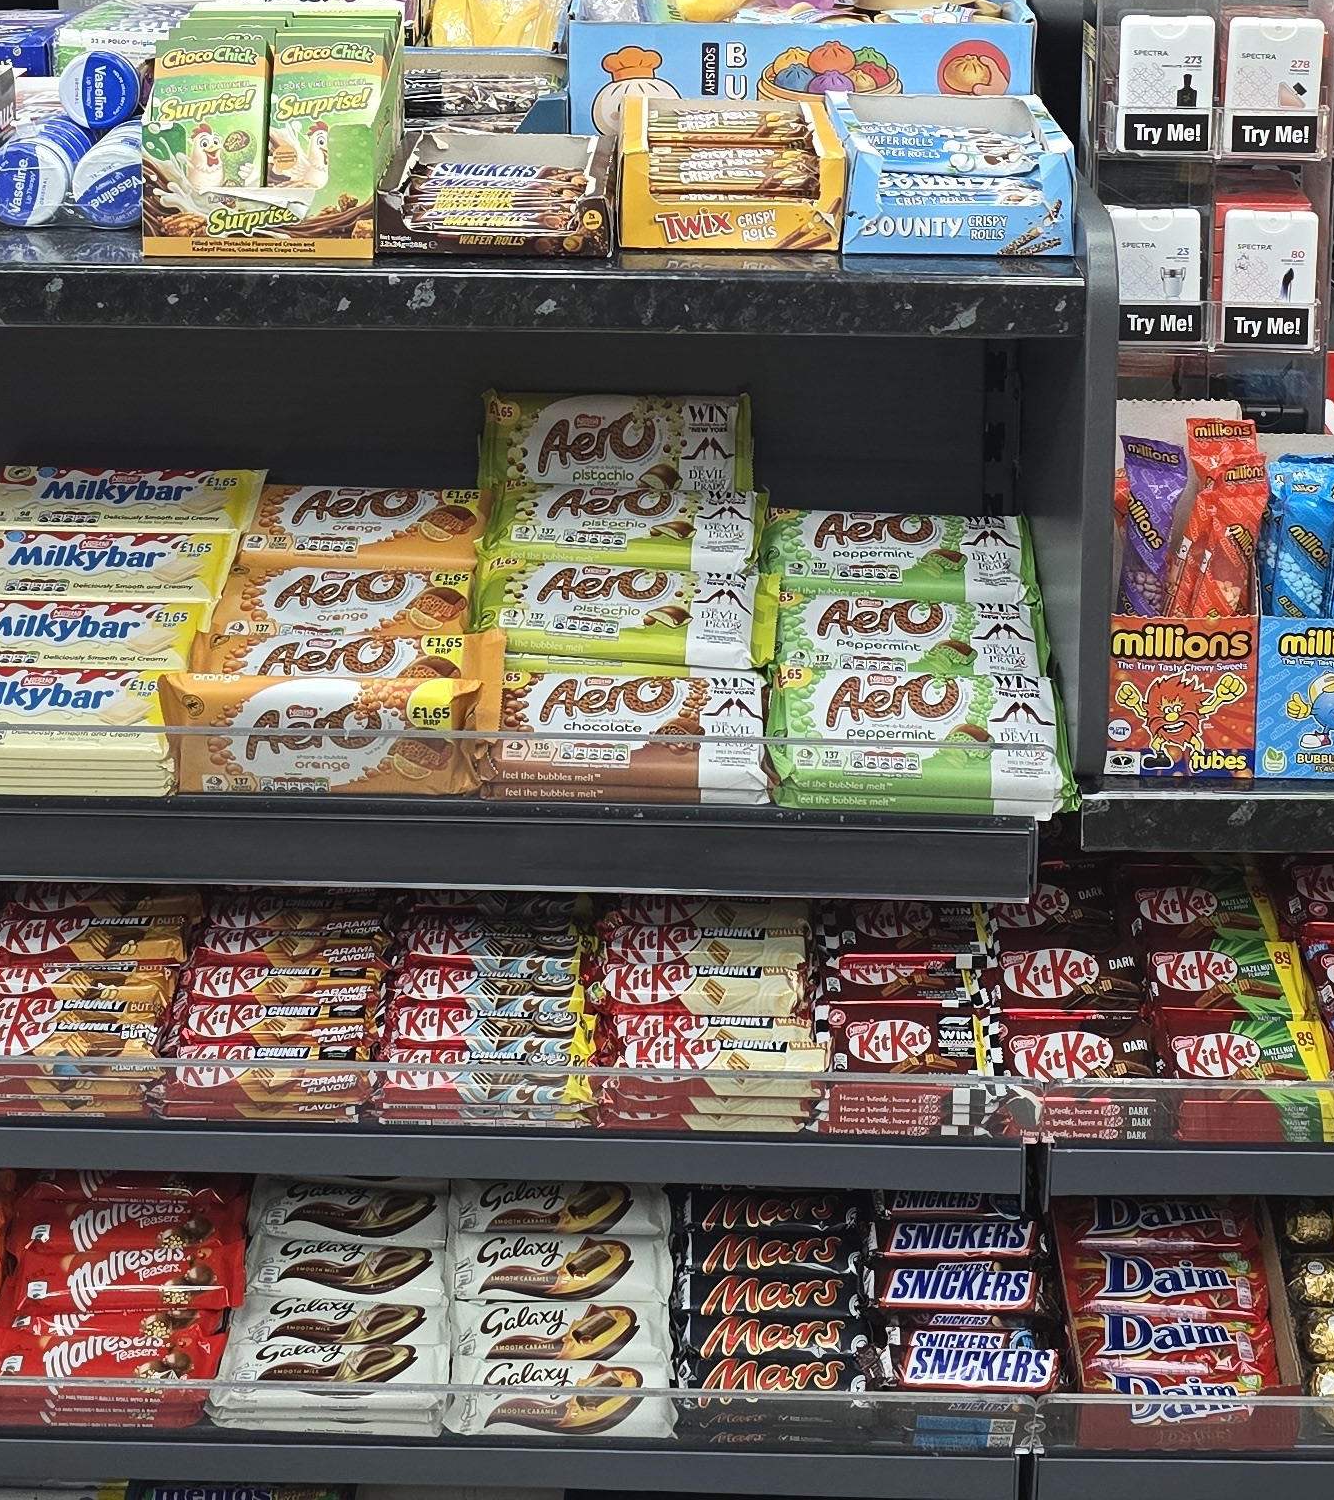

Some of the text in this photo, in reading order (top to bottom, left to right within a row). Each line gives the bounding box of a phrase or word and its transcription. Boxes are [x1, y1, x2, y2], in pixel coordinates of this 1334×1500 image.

[161, 49, 257, 67] ChocoChick
[1133, 49, 1168, 57] SPECTRA
[1184, 56, 1202, 64] 273
[705, 46, 715, 94] SQUISHY
[1290, 60, 1310, 69] 278
[160, 95, 252, 123] Surprise!
[1134, 123, 1200, 144] Try Me!
[1242, 125, 1309, 146] Try Me!
[655, 210, 734, 242] Twix
[736, 212, 776, 229] CRISPY
[863, 216, 962, 238] BOUNTY
[968, 215, 1008, 228] CRISPY
[459, 235, 525, 246] WAFER ROLLS
[742, 225, 777, 242] ROLLS
[971, 228, 1004, 240] ROLLS
[1176, 247, 1189, 256] 23
[1291, 250, 1305, 259] 80
[1127, 315, 1193, 335] Try Me!
[1234, 318, 1300, 337] Try Me!
[1112, 625, 1250, 659] millions
[1118, 662, 1135, 670] The
[1138, 663, 1155, 672] Tiny
[1158, 664, 1181, 672] Tasty
[1184, 663, 1214, 672] Chewy
[412, 705, 449, 721] £1.65
[563, 721, 642, 734] chocolate
[846, 726, 935, 741] peppermint
[295, 760, 350, 772] orange
[1190, 751, 1247, 771] tubes
[1108, 958, 1136, 970] DARK
[1009, 954, 1097, 994] KitKat
[894, 1221, 1031, 1251] SNICKERS
[1105, 1254, 1229, 1295] Daim
[705, 1275, 841, 1315] Mars
